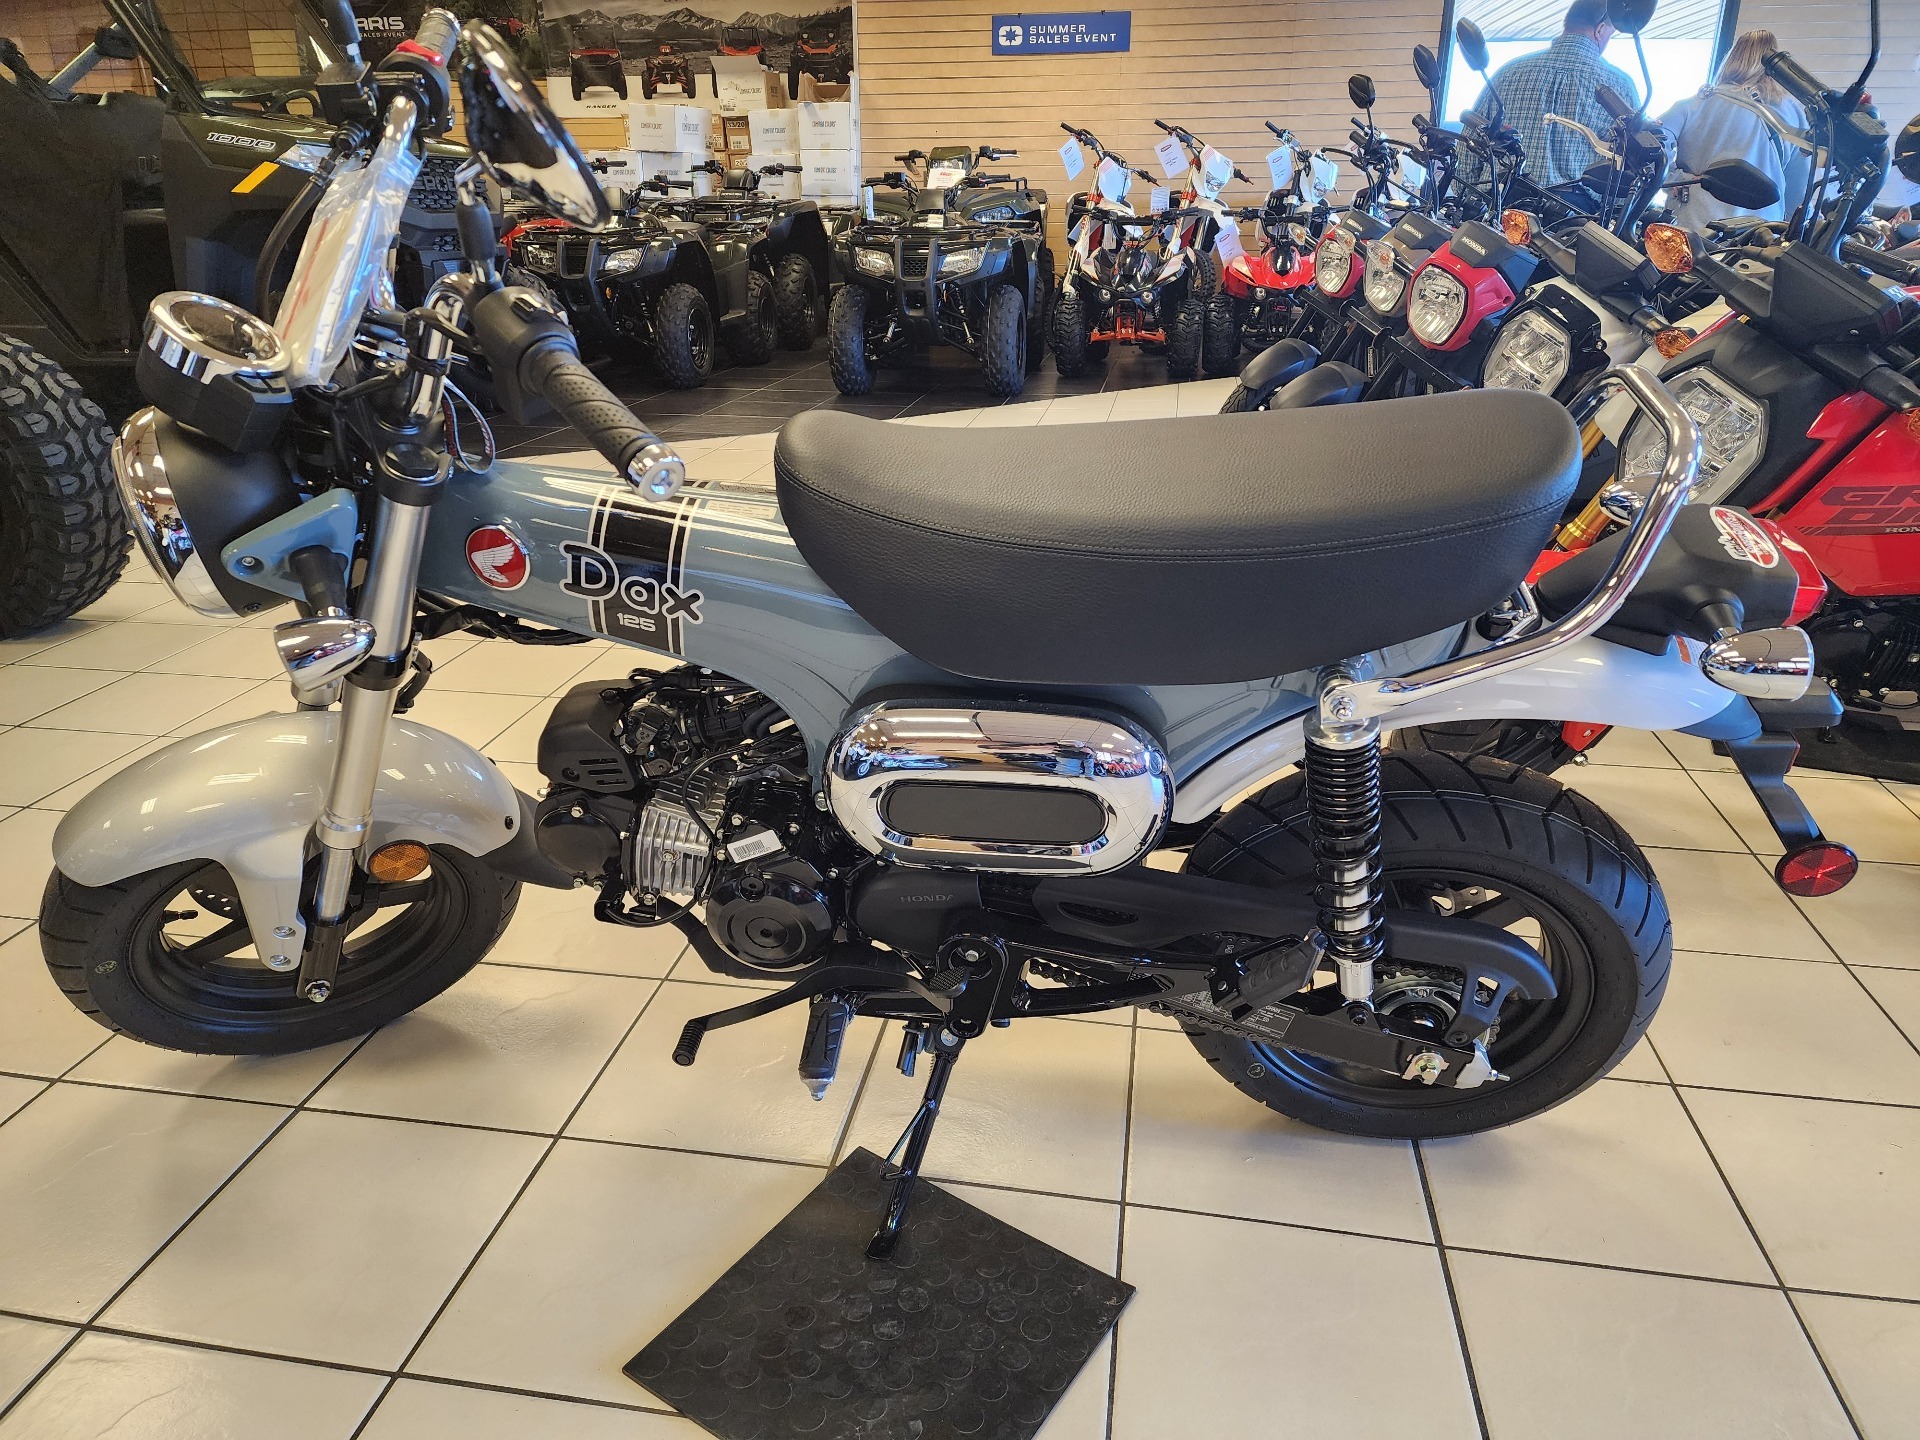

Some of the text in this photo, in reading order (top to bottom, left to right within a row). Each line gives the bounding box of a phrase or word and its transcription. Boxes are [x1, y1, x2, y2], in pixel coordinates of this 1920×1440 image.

[1029, 24, 1086, 34] SUMMER
[1029, 33, 1117, 44] SALES EVENT
[206, 132, 277, 150] 1000
[1402, 223, 1424, 239] HONDA
[1462, 236, 1488, 256] HONDA
[559, 540, 705, 625] Dax
[616, 612, 656, 632] 125
